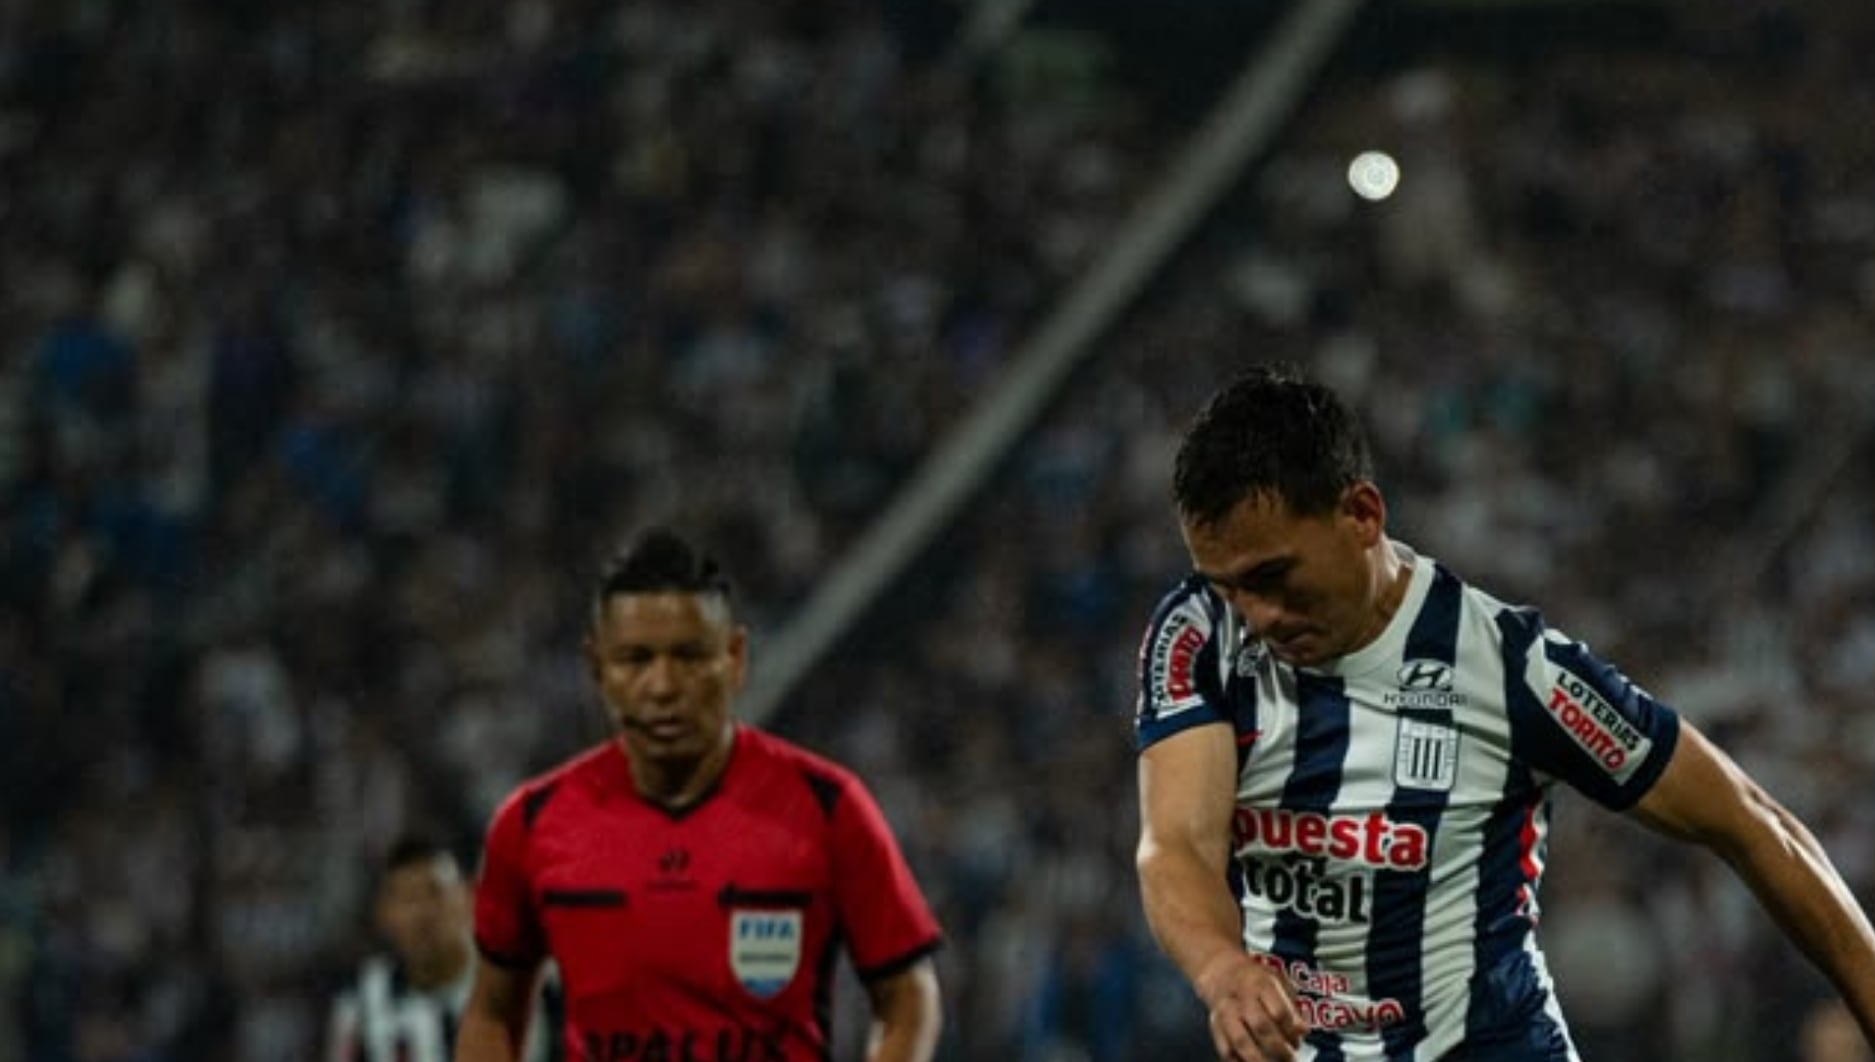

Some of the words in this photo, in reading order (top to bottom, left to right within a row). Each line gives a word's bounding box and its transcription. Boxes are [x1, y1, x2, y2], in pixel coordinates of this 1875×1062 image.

[1548, 686, 1627, 769] TORITO
[1557, 671, 1641, 751] LOTERIAS
[1243, 854, 1369, 924] total
[738, 917, 796, 940] FIFA
